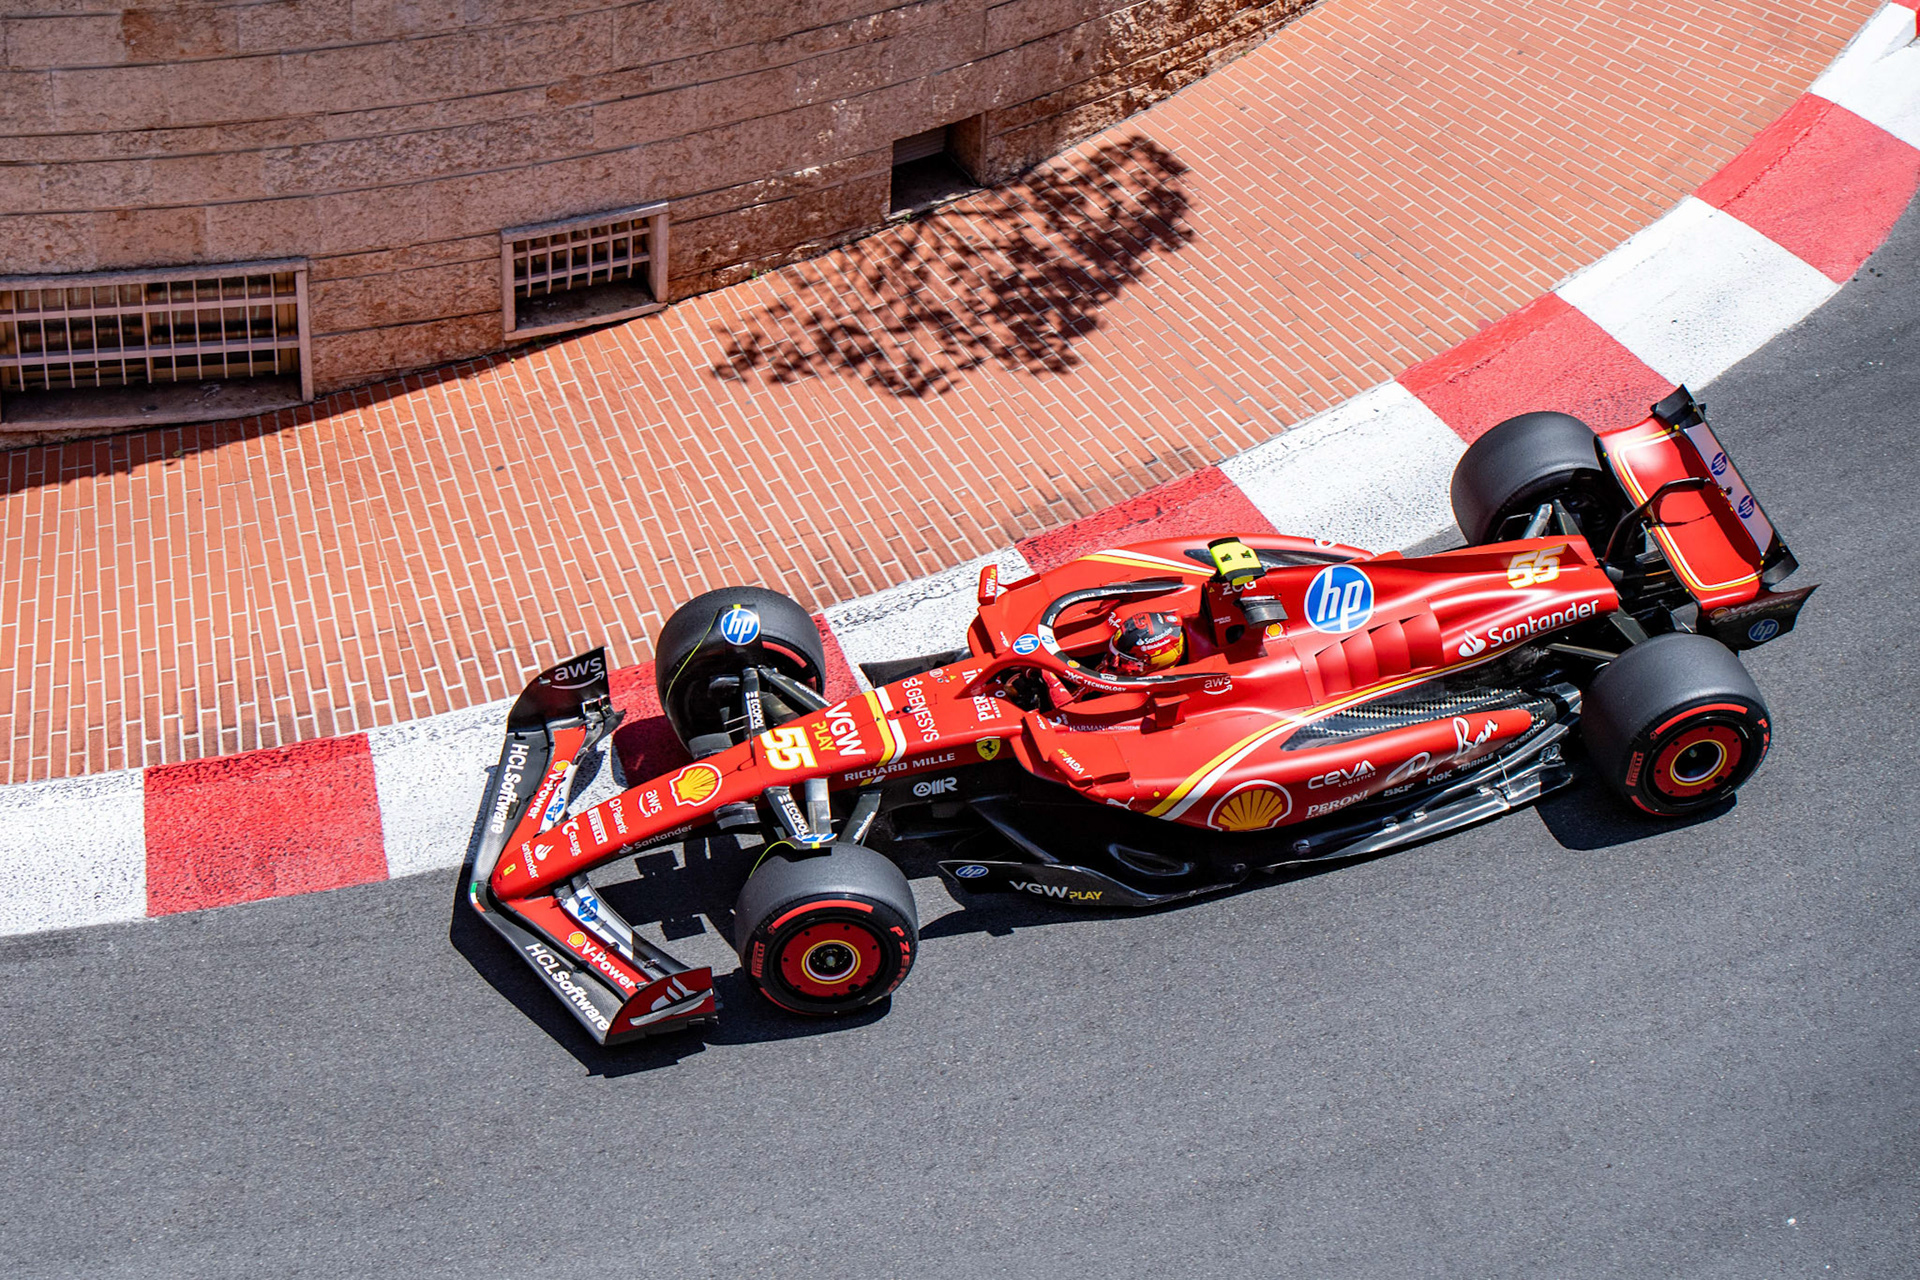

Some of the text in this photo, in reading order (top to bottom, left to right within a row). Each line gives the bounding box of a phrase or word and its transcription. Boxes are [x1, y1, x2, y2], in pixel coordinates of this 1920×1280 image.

[1711, 452, 1727, 476] hp
[1738, 495, 1754, 519] hp
[1507, 544, 1568, 589] 55
[1313, 563, 1368, 634] hp
[725, 608, 755, 645] hp
[1144, 627, 1174, 645] Santander
[1488, 600, 1599, 649] Santander
[1751, 619, 1777, 642] hp
[553, 656, 603, 682] aws
[1204, 674, 1231, 689] aws
[1083, 679, 1127, 692] TECHNOLOGY
[750, 699, 765, 728] ECOPOL
[905, 688, 940, 743] GENESYS
[1069, 724, 1106, 732] HARMAN
[811, 720, 836, 752] PLAY
[824, 701, 866, 757] VGW
[1508, 719, 1547, 749] brembo
[760, 726, 818, 770] 55
[844, 752, 956, 782] RICHARD MILLE
[1063, 756, 1085, 775] VGW
[1338, 772, 1377, 788] LOGISTICS
[1427, 770, 1452, 785] NGK
[645, 789, 662, 815] aws
[1307, 789, 1370, 816] PERONI
[587, 807, 609, 845] PIRELLI
[611, 806, 629, 835] Palantir
[785, 802, 811, 836] ECOPOL
[634, 824, 693, 850] Santander
[959, 865, 986, 879] hp
[1009, 880, 1103, 901] VGW PLAY
[584, 940, 636, 990] V-Power
[751, 941, 766, 978] PIRELLI
[525, 943, 610, 1032] HCLSoftware
